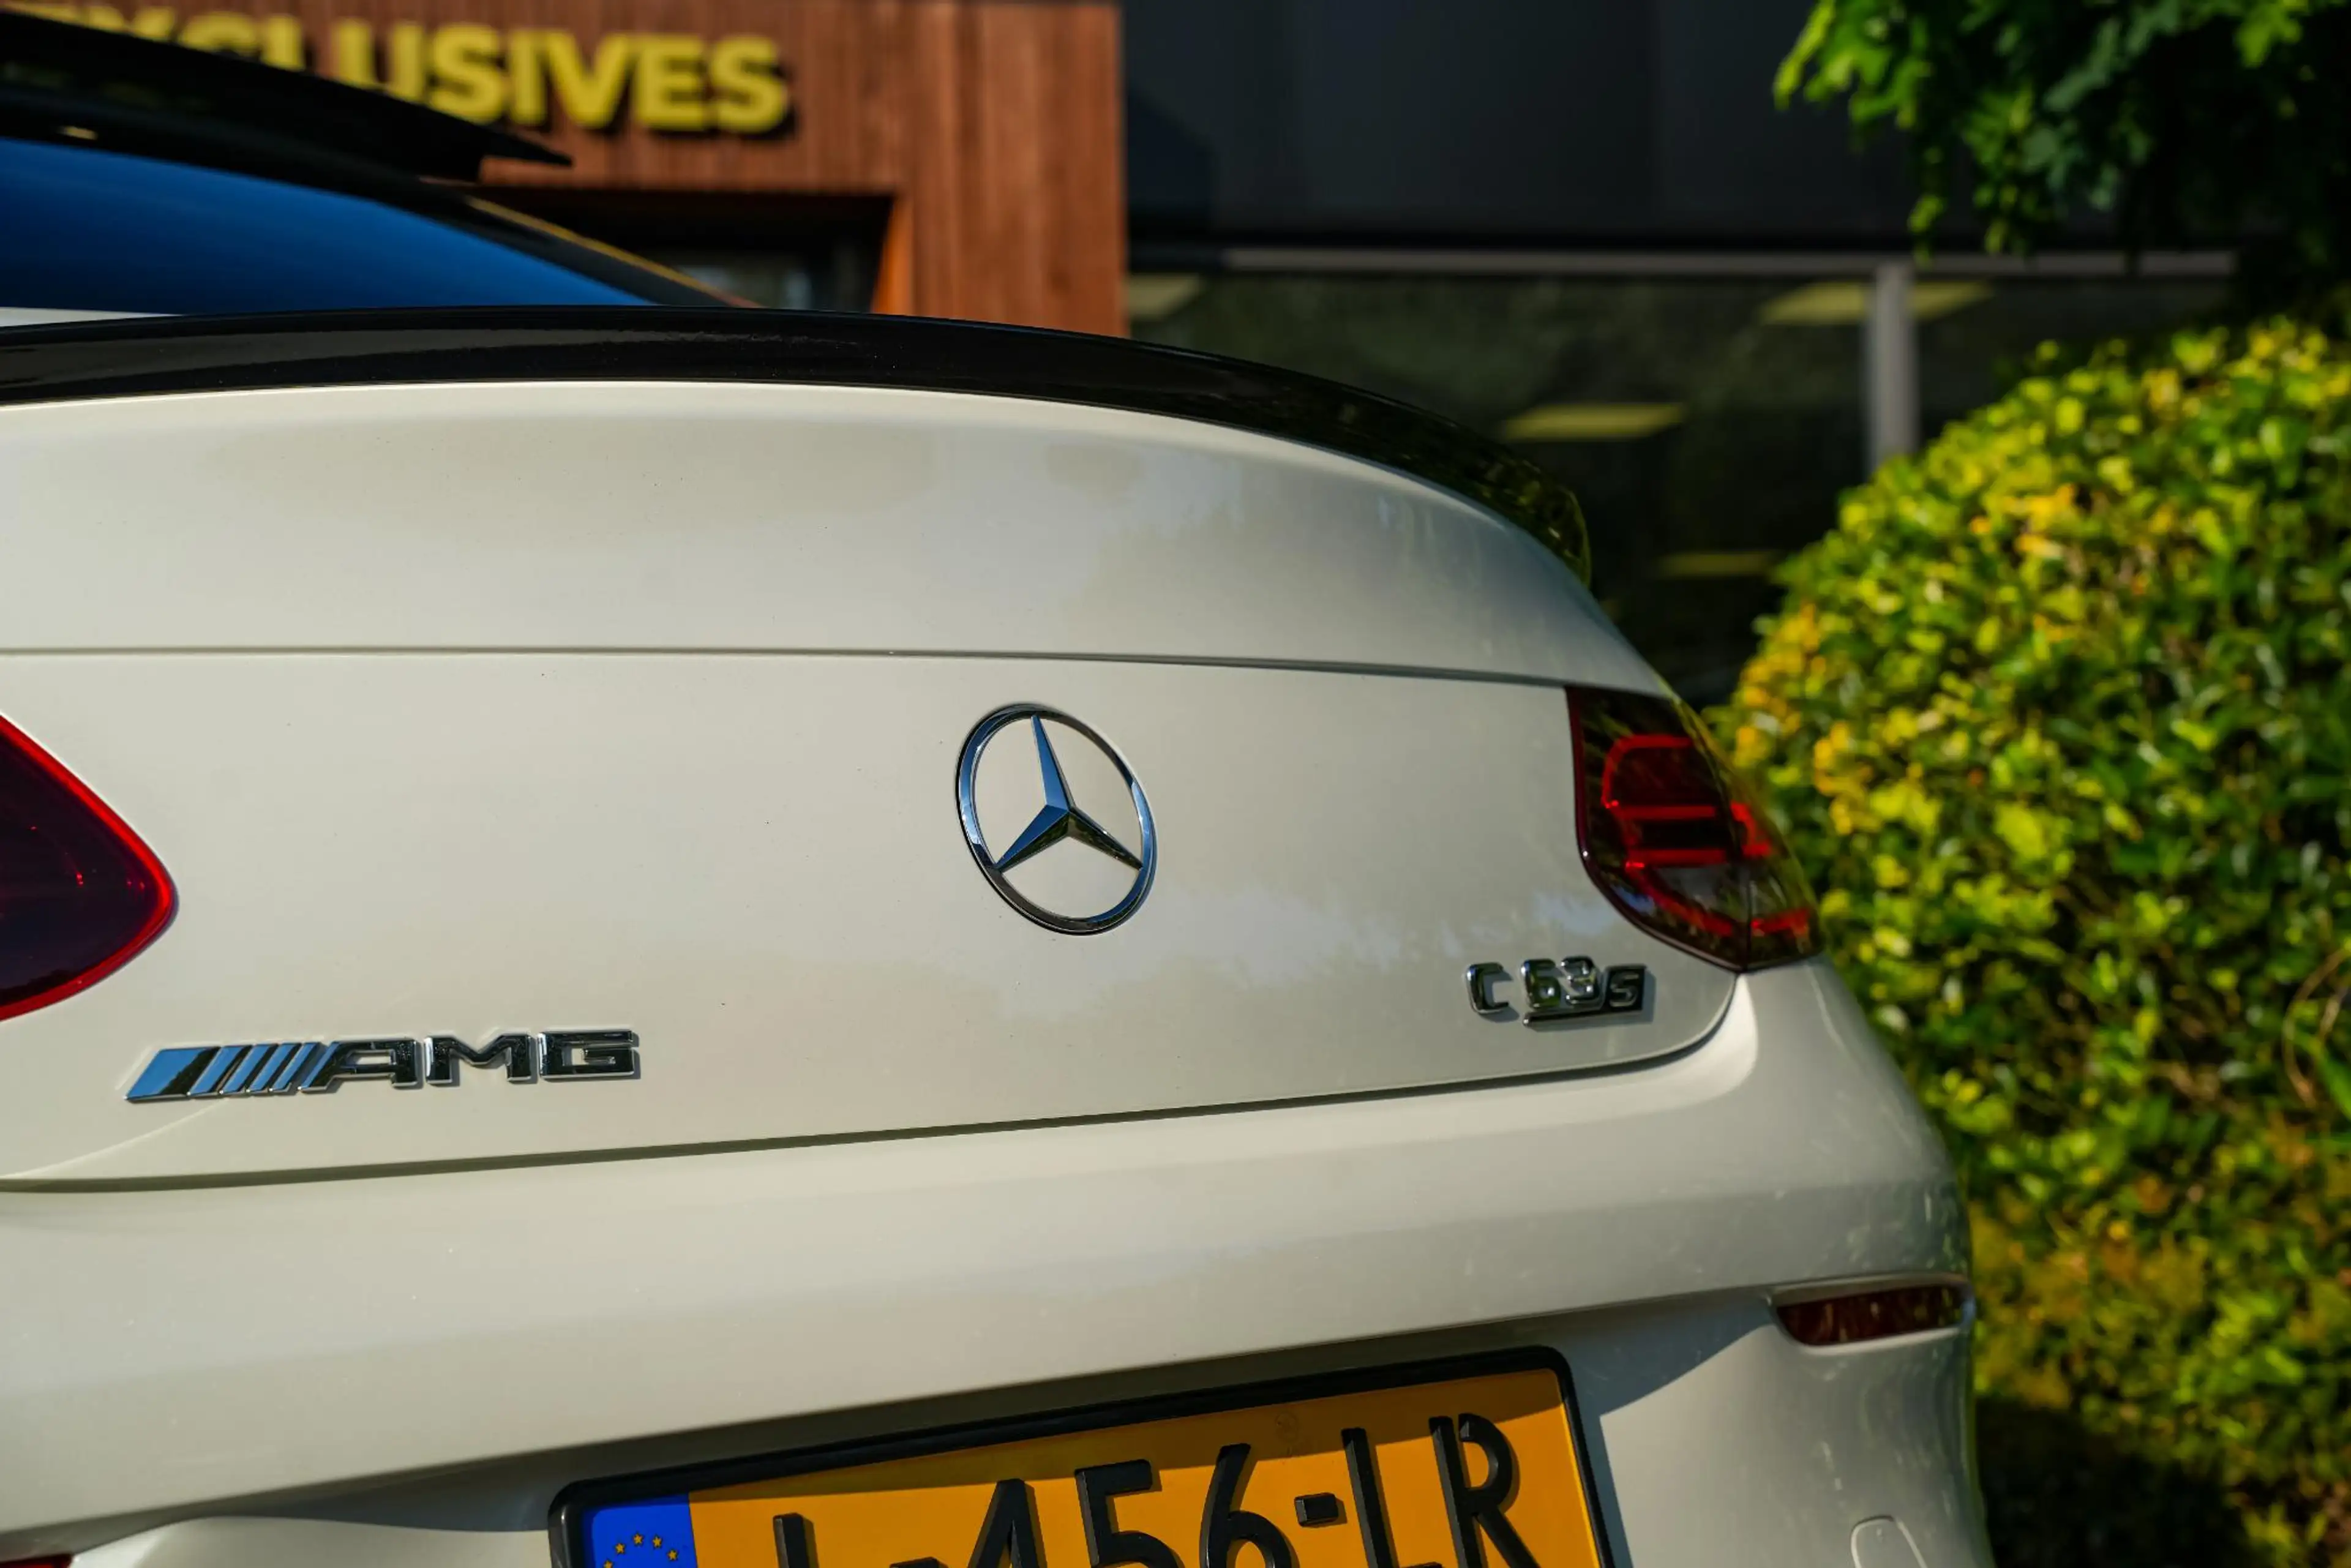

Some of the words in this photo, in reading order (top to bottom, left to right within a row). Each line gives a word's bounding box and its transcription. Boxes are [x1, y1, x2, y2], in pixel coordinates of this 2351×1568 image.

[0, 0, 788, 132] USIVES
[1465, 962, 1510, 1014] C
[298, 1030, 634, 1092] AMG
